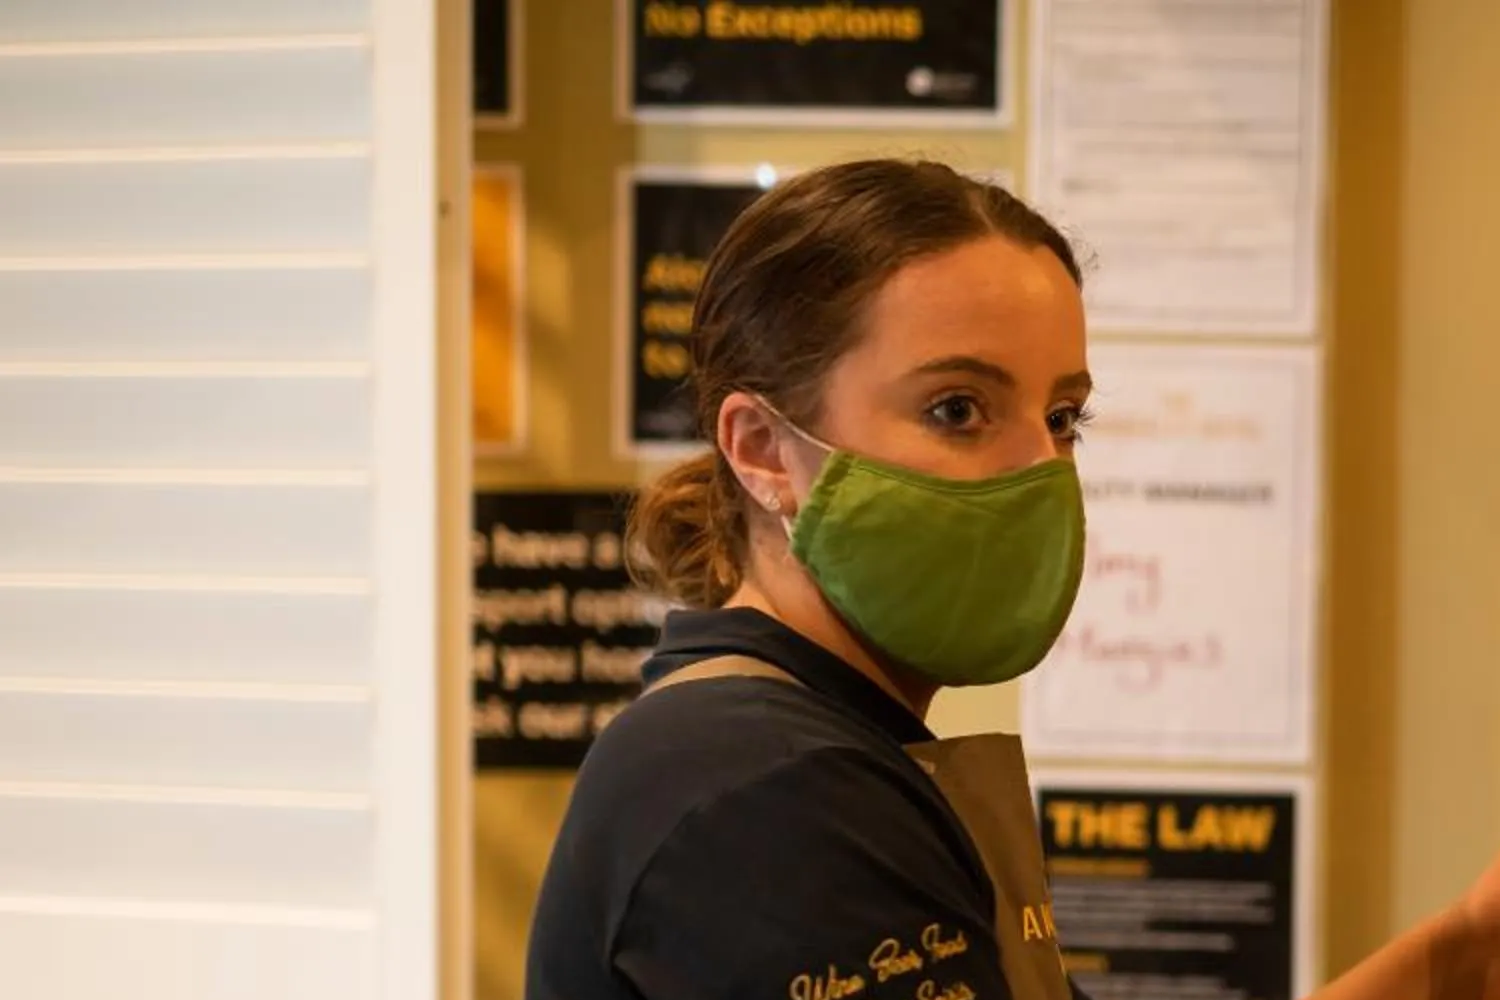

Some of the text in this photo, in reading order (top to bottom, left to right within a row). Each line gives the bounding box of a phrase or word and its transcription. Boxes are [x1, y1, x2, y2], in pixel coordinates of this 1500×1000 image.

[646, 4, 923, 45] No Exceptions
[1049, 801, 1276, 850] THE LAW
